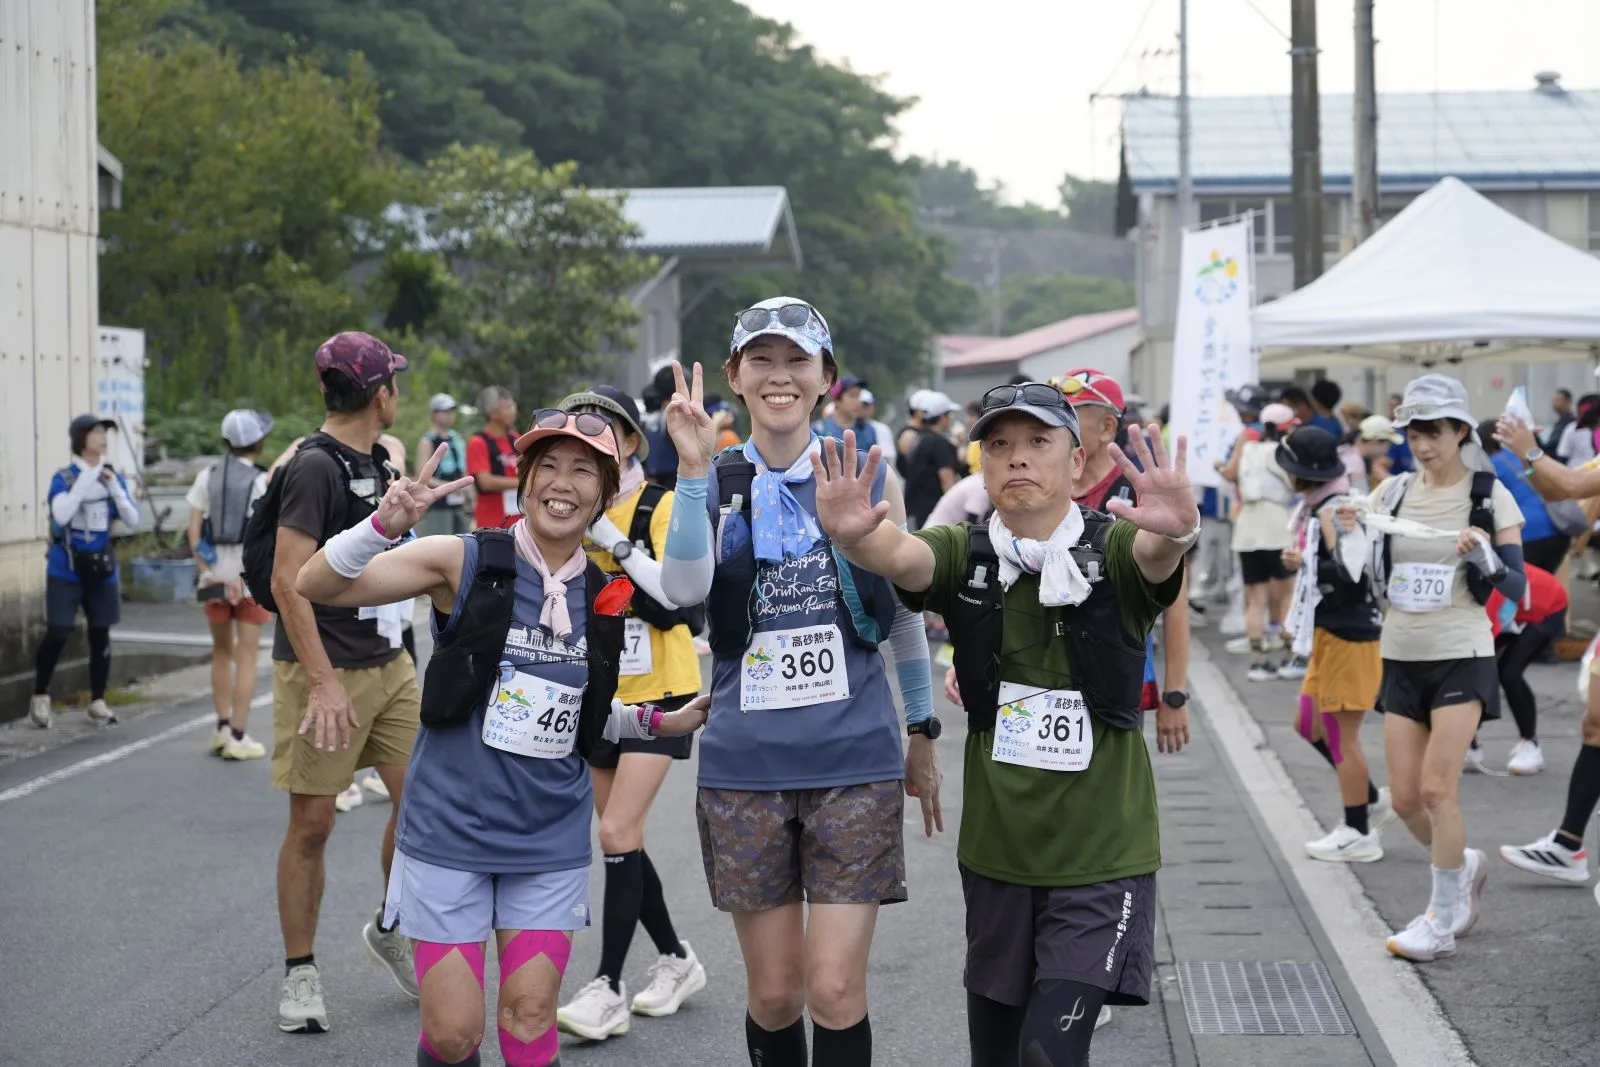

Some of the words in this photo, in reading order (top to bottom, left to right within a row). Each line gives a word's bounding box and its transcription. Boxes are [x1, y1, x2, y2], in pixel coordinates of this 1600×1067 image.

[1413, 578, 1445, 596] 370
[792, 630, 835, 648] 高砂熱学
[503, 646, 536, 661] unning
[537, 652, 562, 663] Team
[781, 648, 834, 680] 360
[537, 707, 580, 733] 463
[1038, 714, 1084, 742] 361
[1105, 931, 1123, 973] DSIGN
